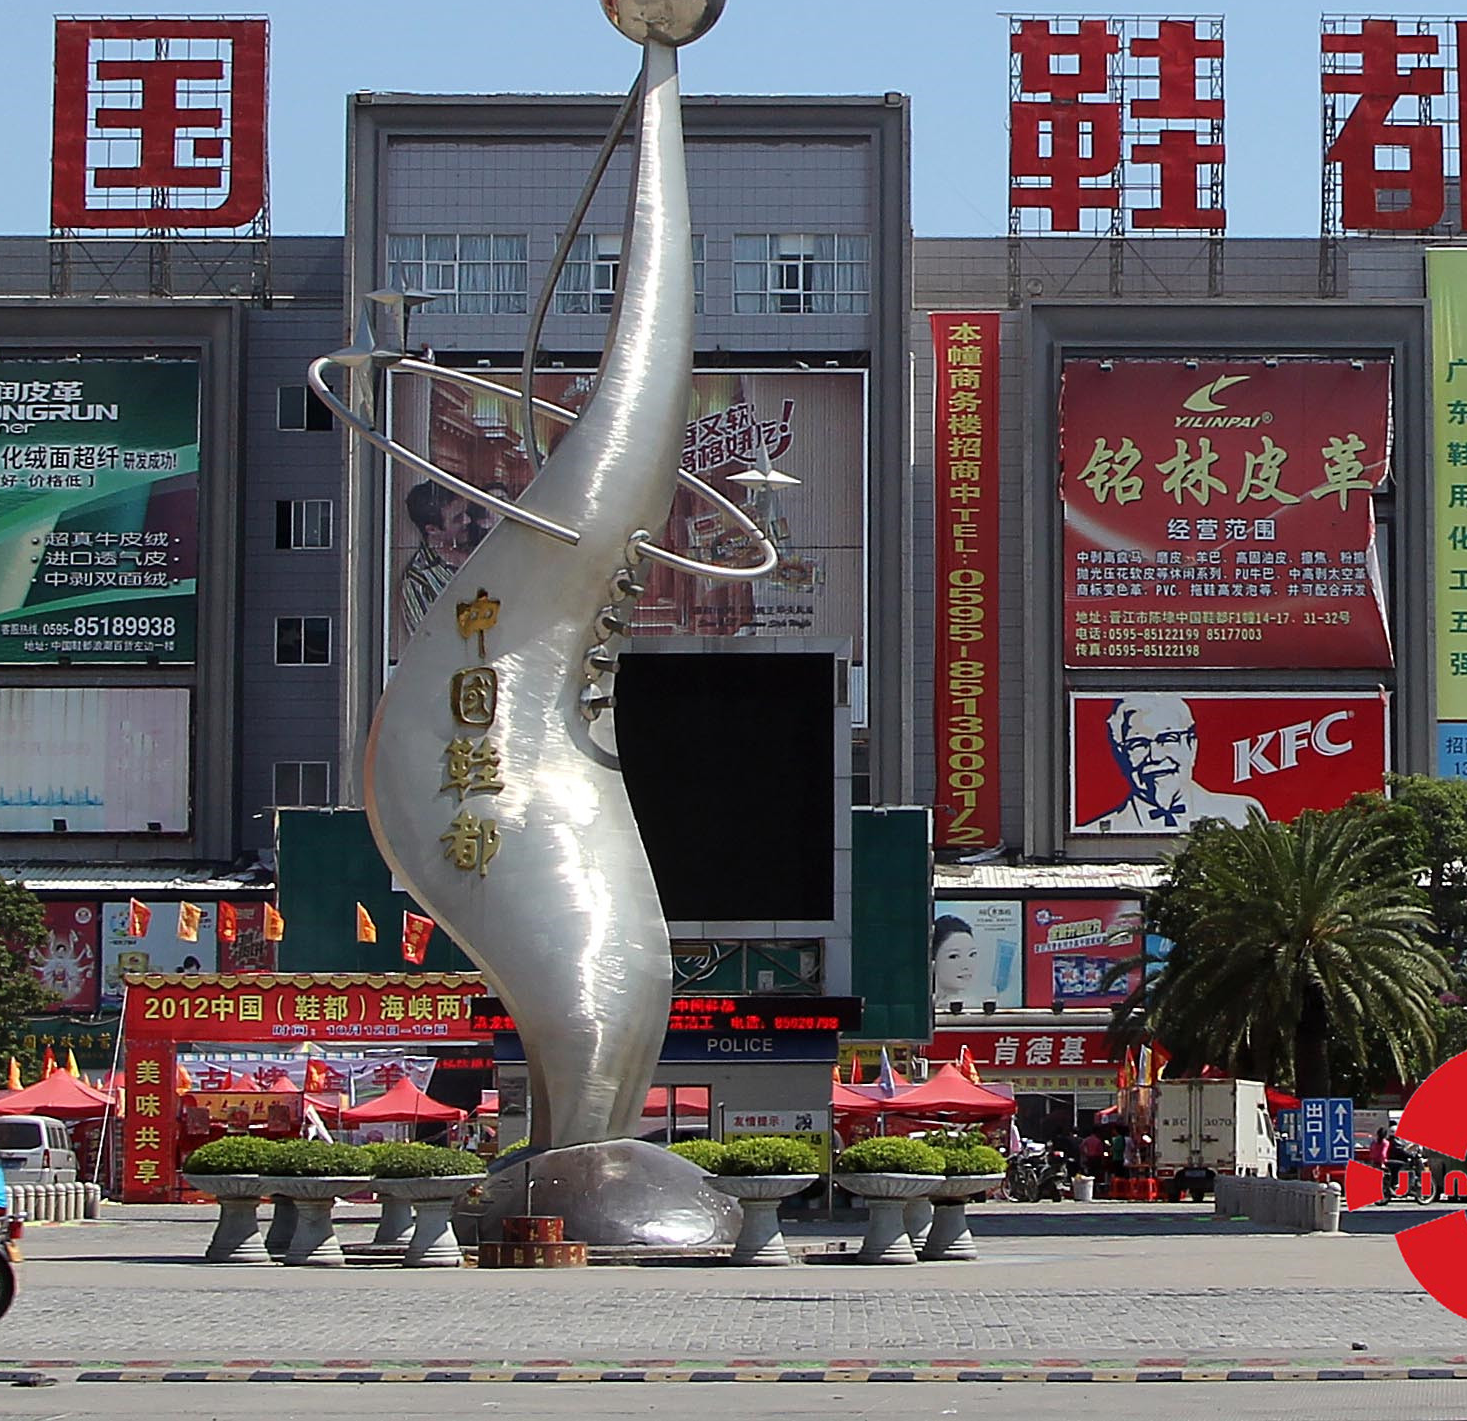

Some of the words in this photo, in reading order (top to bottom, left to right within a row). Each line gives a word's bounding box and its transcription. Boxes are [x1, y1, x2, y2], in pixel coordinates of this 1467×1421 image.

[947, 321, 983, 506] 本幢商务楼招商中
[1174, 414, 1262, 430] YILINPAI
[1077, 434, 1373, 511] 铭林皮革
[45, 532, 169, 547] 超真牛皮绒
[1167, 518, 1277, 542] 经营范围
[45, 551, 168, 566] 进口透气皮
[42, 616, 176, 637] 0595-85189938
[1075, 627, 1200, 641] 电话:0595-85122199
[1206, 628, 1262, 641] 85177003
[1075, 643, 1200, 657] 传真:0595-85122198
[1232, 710, 1352, 785] KFC
[706, 1037, 773, 1054] POLICE
[994, 1036, 1088, 1066] 肯德基
[133, 1058, 162, 1185] 美味共享
[1305, 1103, 1323, 1133] 出口
[1332, 1130, 1351, 1159] 入口
